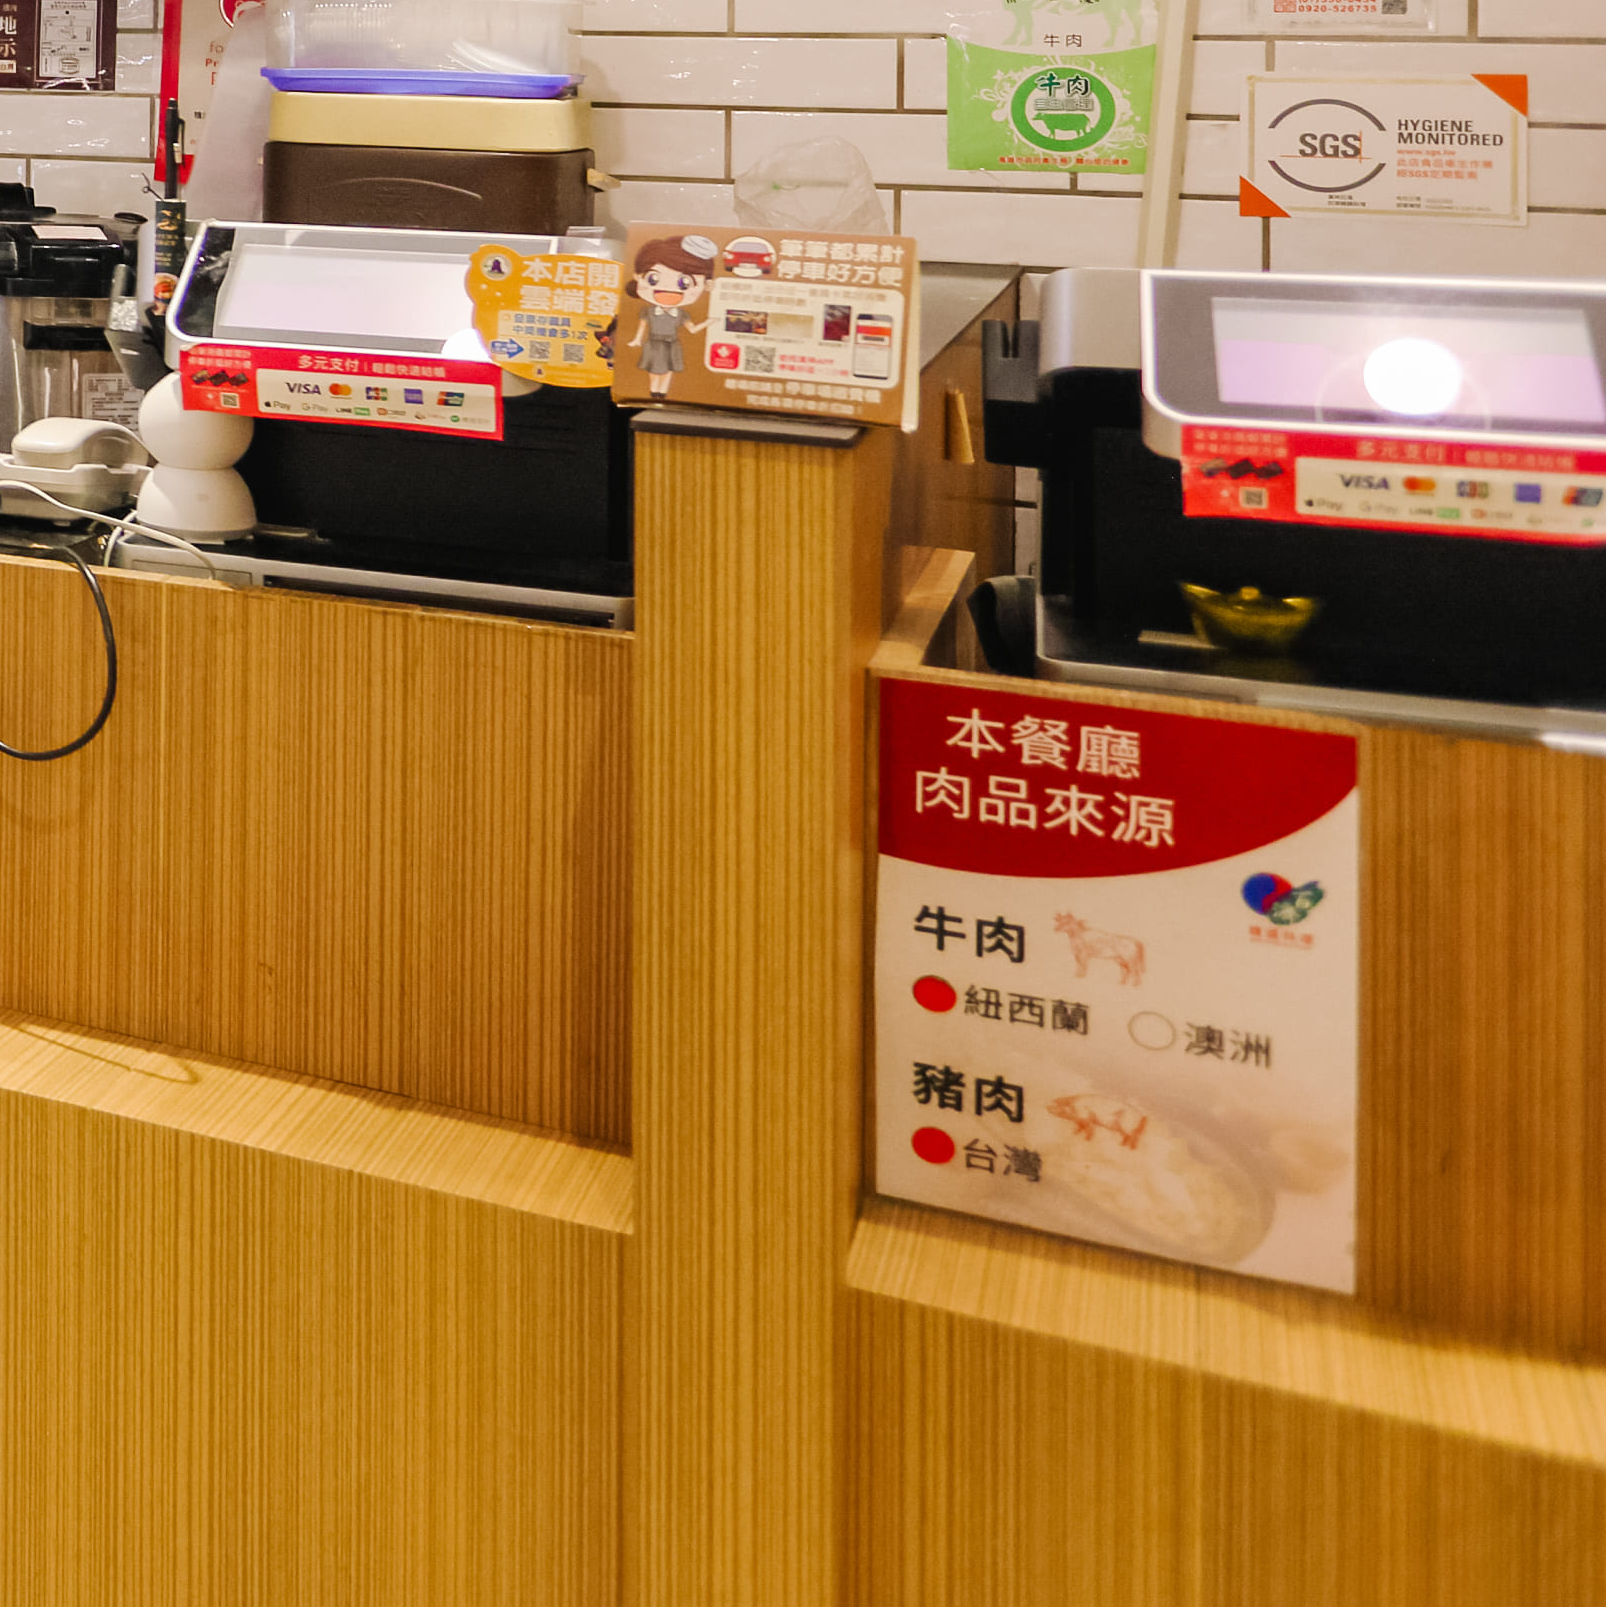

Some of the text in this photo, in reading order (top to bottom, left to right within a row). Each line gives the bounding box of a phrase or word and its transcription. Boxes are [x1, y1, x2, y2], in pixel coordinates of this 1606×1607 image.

[1043, 32, 1083, 48] 牛肉
[1034, 72, 1090, 97] 牛肉
[1397, 118, 1474, 133] HYGIENE
[1298, 133, 1361, 158] SGS
[1397, 131, 1504, 147] MONITORED
[521, 257, 621, 289] 本店開
[777, 259, 904, 287] 停車好方便
[297, 354, 361, 373] 多元支付
[285, 381, 322, 395] VISA
[1338, 472, 1392, 492] VISA
[945, 708, 1141, 781] 本餐廳
[914, 766, 1177, 849] 肉品來源
[913, 904, 1026, 964] 牛肉
[964, 984, 1273, 1069] 紐西蘭 澳洲
[912, 1061, 1025, 1124] 豬肉
[963, 1138, 1043, 1184] 台灣
